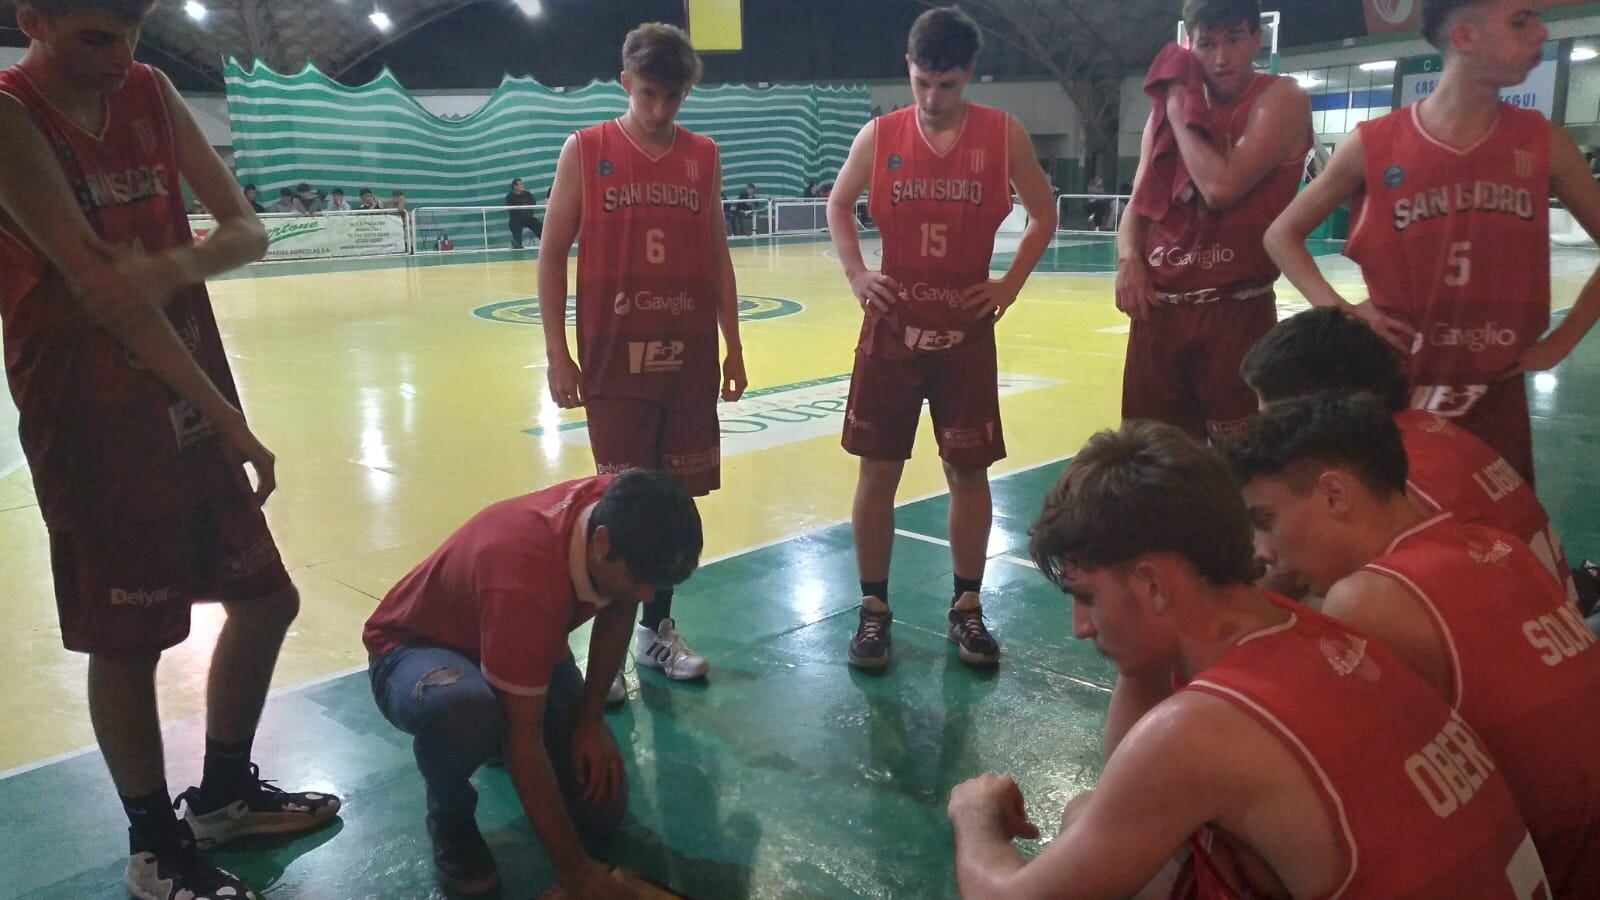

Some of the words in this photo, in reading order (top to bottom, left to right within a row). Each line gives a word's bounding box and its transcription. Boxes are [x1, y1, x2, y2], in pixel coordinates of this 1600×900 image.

[604, 183, 641, 211] SAN
[645, 183, 700, 213] ISIDRO
[892, 180, 925, 204] SAN
[930, 180, 983, 205] ISIDRO
[1393, 186, 1449, 230] SAN
[646, 228, 666, 264] 6
[920, 223, 948, 257] 15
[1166, 244, 1235, 269] Gaviglio
[1444, 241, 1472, 286] 5
[635, 290, 696, 316] Gaviglio
[911, 282, 962, 308] Gavig
[1430, 321, 1517, 353] Gaviglio
[110, 586, 170, 608] Delyar
[1404, 709, 1495, 818] OBER
